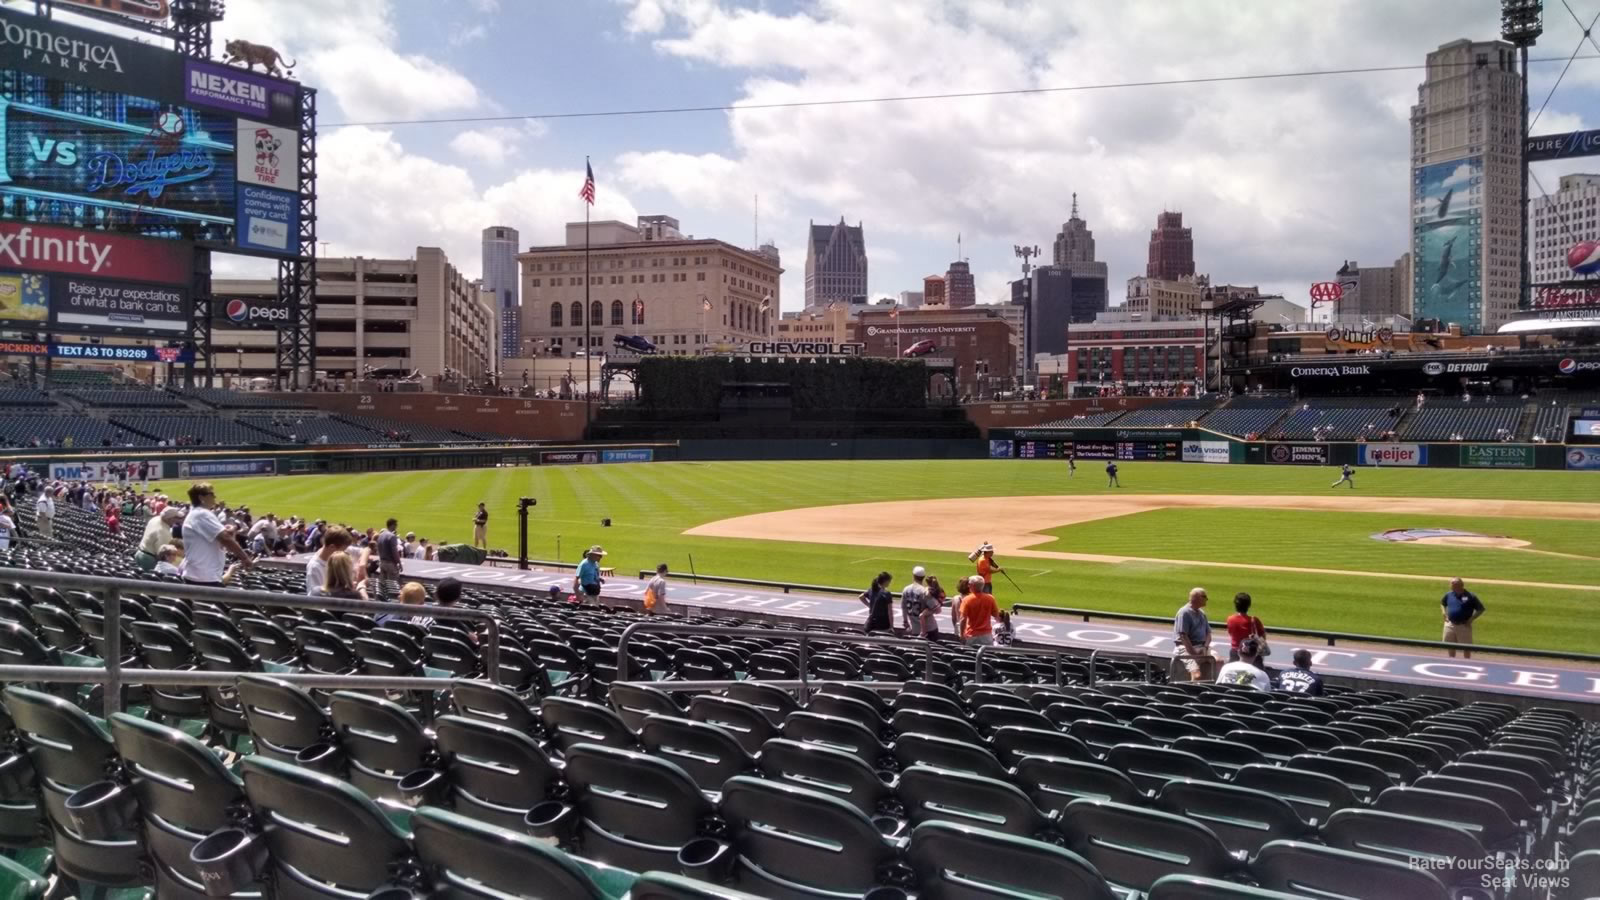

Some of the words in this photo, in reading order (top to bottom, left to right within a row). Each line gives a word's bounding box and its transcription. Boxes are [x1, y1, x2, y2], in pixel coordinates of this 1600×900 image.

[23, 48, 88, 73] PARK
[191, 70, 265, 103] NEXEN
[191, 87, 245, 105] PERFORMANCE
[246, 100, 266, 110] TIRES
[1528, 139, 1562, 151] PURE
[87, 147, 214, 199] Dodgers
[255, 165, 280, 176] BELLE
[257, 174, 275, 184] TIRE
[244, 188, 290, 203] Confidence
[244, 199, 271, 209] comes
[272, 201, 290, 212] with
[244, 207, 267, 218] every
[269, 208, 288, 220] card.
[68, 281, 96, 296] Raise
[99, 286, 119, 298] your
[123, 287, 181, 302] expectations
[1313, 283, 1341, 298] AAA
[71, 296, 81, 305] of
[83, 296, 108, 308] what
[110, 300, 117, 309] a
[120, 300, 144, 311] bank
[146, 303, 164, 312] can
[166, 302, 181, 313] be.
[249, 306, 289, 320] pepsi
[57, 346, 83, 355] TEXT
[84, 347, 98, 356] A3
[100, 348, 115, 357] TO
[115, 348, 147, 359] 89269
[749, 342, 864, 355] CHEVROLET
[1342, 365, 1370, 375] Bank
[1447, 363, 1489, 372] DETROIT
[1371, 447, 1414, 462] meijer
[1469, 445, 1526, 457] EASTERN
[421, 565, 573, 587] HOME
[693, 591, 832, 611] THE
